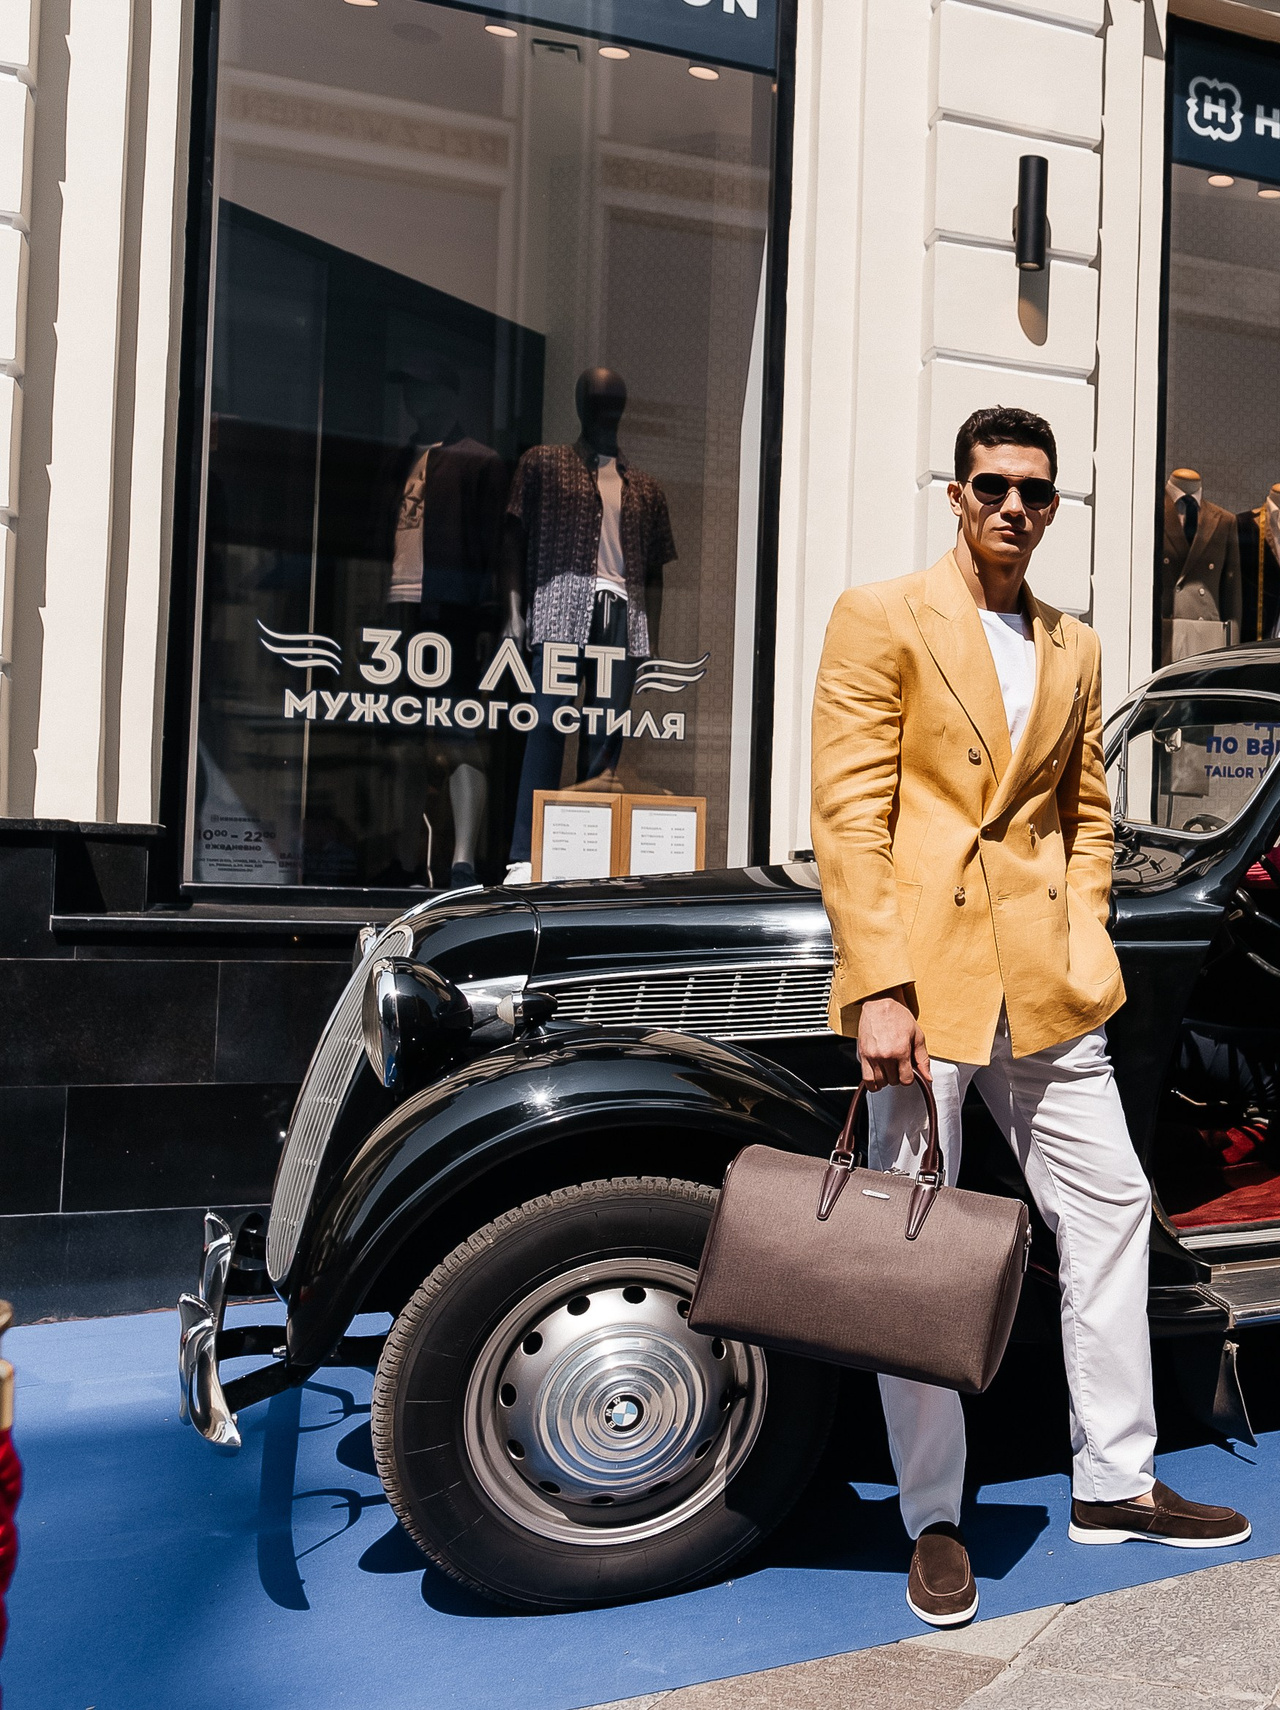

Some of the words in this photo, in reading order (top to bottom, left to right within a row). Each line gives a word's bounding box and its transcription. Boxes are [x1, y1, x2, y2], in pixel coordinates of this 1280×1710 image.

[358, 627, 453, 690] 30
[479, 637, 626, 699] ЛЕТ
[283, 688, 539, 732] МУЖСКОГО
[551, 703, 686, 741] СТИЛЯ
[1206, 736, 1238, 755] по
[1204, 764, 1254, 779] TAILOR
[204, 843, 262, 852] ежедневно
[605, 1396, 622, 1429] BMW
